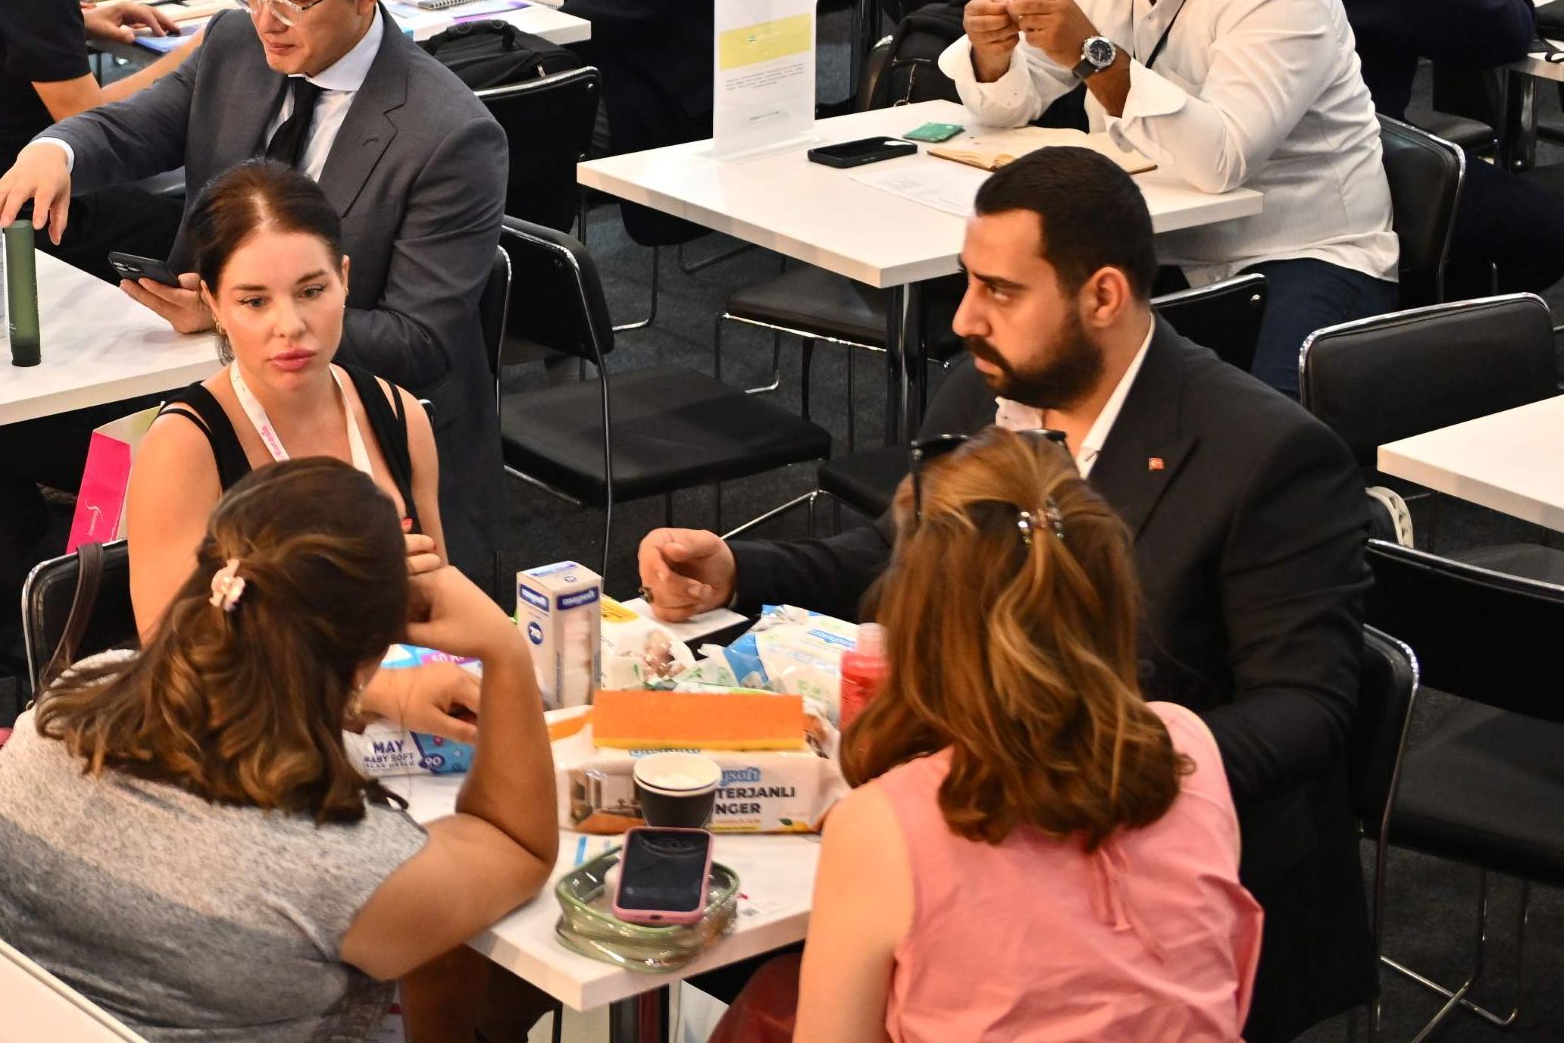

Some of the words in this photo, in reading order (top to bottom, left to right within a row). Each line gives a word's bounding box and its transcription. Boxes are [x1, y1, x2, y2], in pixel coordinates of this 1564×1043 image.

[372, 740, 404, 754] MAY
[391, 752, 414, 761] SOFT
[720, 766, 761, 787] ysoft
[716, 786, 796, 799] TERJANLI
[715, 803, 761, 815] NGER
